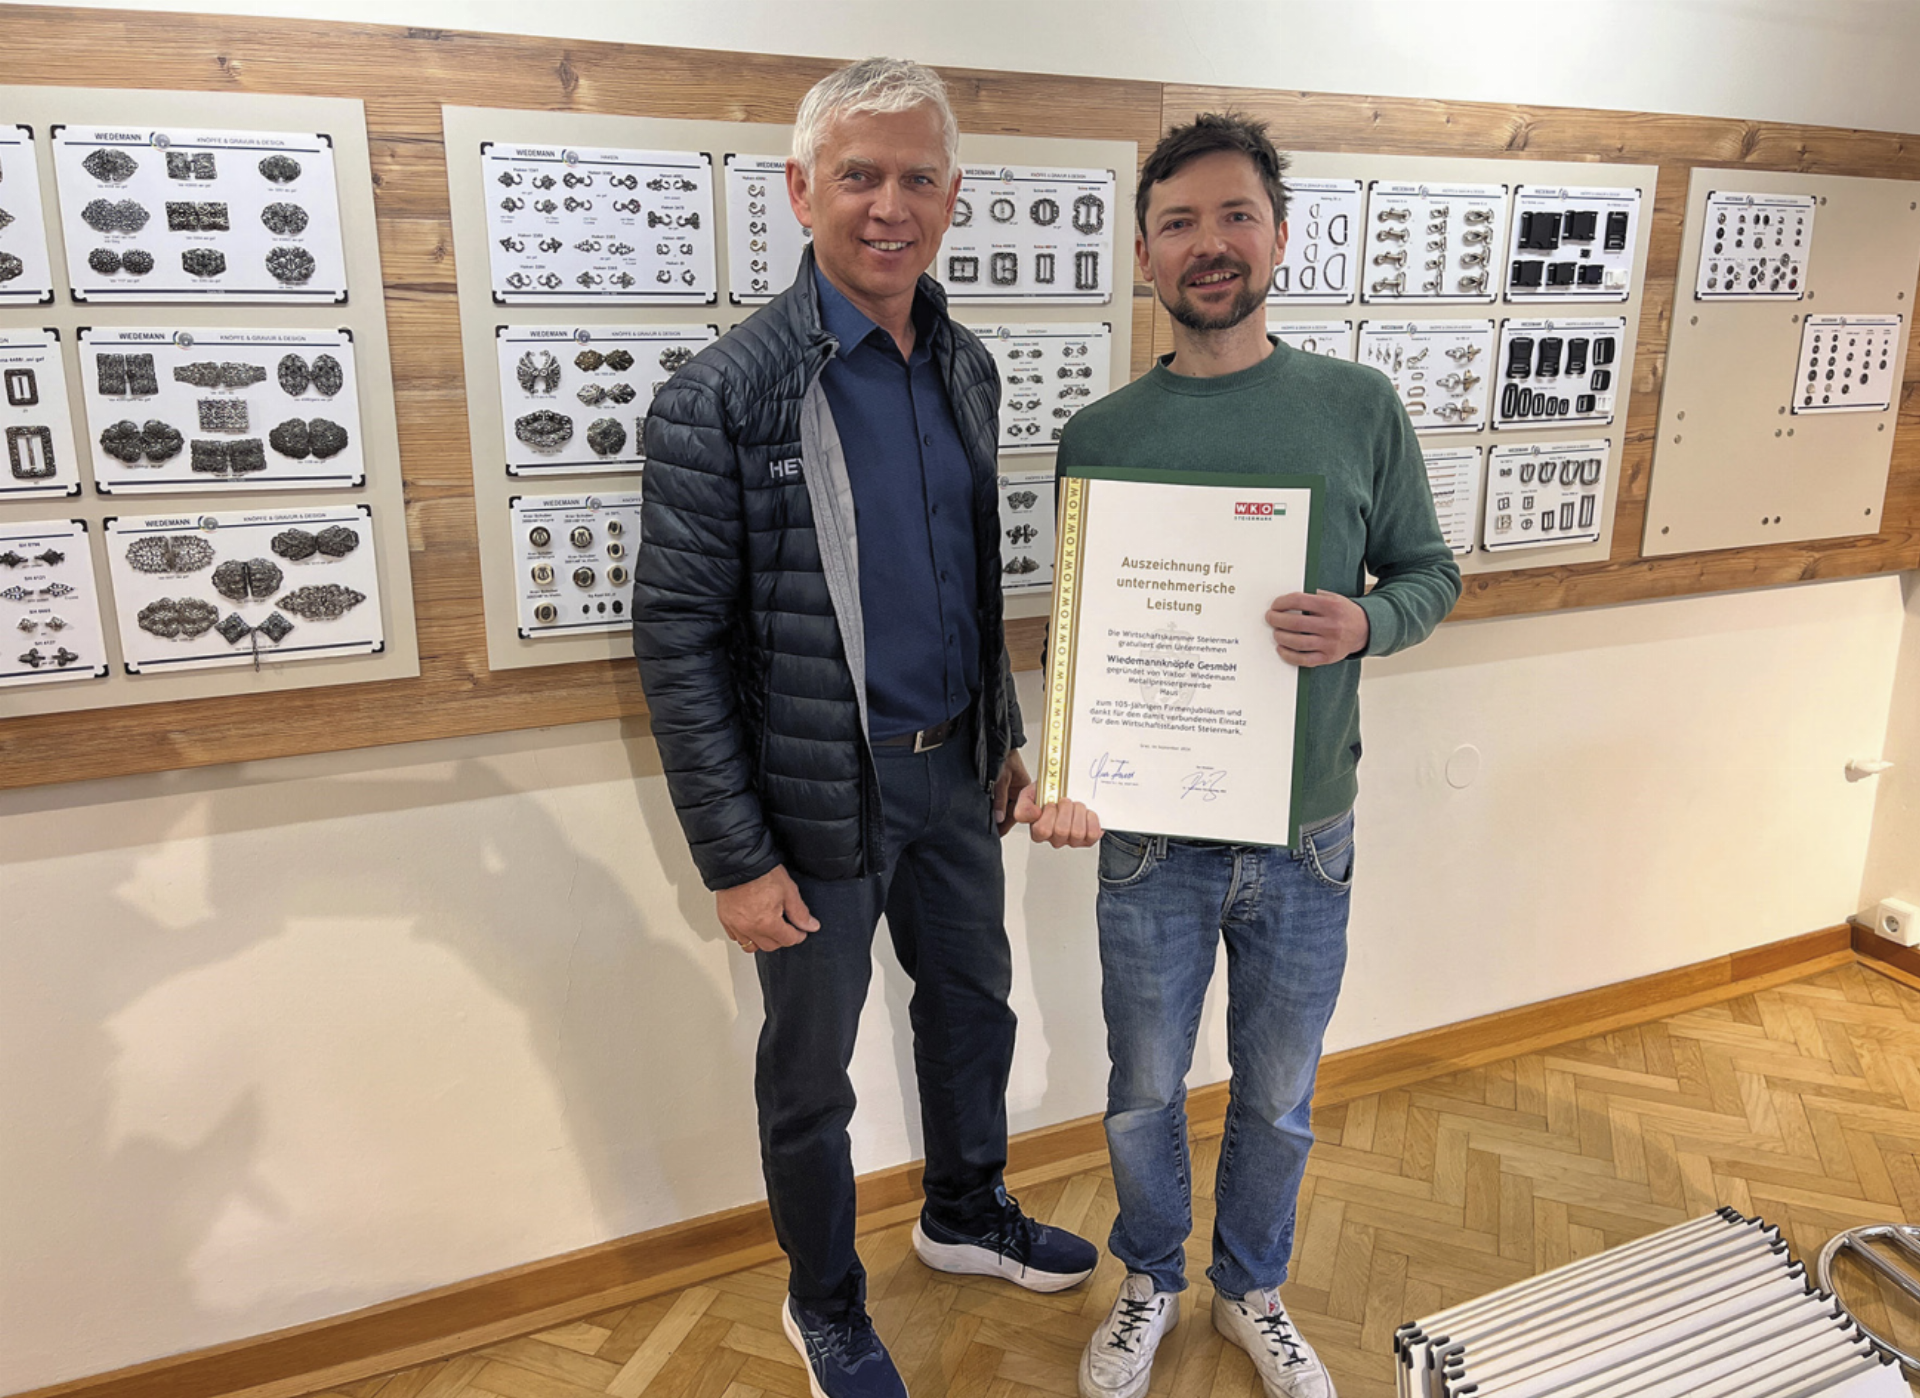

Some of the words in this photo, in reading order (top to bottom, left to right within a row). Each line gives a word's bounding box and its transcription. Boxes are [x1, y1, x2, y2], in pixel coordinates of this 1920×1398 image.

[94, 133, 142, 141] WIEDEMANN
[516, 149, 555, 158] WIEDEMANN
[529, 330, 568, 338] WIEDEMANN
[543, 499, 580, 507] WIEDEMANN
[1236, 503, 1272, 514] WKO
[145, 519, 191, 528] WIEDEMANN
[1121, 556, 1210, 575] Auszeichnung
[1214, 562, 1234, 574] für
[1117, 577, 1236, 594] unternehmerische
[1147, 598, 1202, 615] Leistung
[1107, 629, 1121, 637] Die
[1122, 630, 1195, 642] Wirtschaftskammer
[1197, 636, 1239, 645] Steiermark
[1118, 640, 1154, 649] gratuliert
[1155, 642, 1172, 650] dem
[1174, 643, 1227, 653] Unternehmen
[1106, 654, 1195, 670] Wiedemannknöpfe
[1197, 661, 1237, 672] GesmbH
[1106, 666, 1145, 676] gegründet
[1147, 669, 1161, 677] von
[1162, 670, 1186, 678] Viktor
[1190, 672, 1236, 681] Wiedemann
[1089, 708, 1111, 716] dankt
[1113, 709, 1124, 717] für
[1126, 710, 1141, 718] den
[1142, 712, 1164, 720] damit
[1165, 714, 1217, 724] verbundenen
[1218, 717, 1247, 726] Einsatz
[1163, 703, 1225, 716] Firmenjubiläum
[1226, 709, 1242, 717] und
[1091, 717, 1103, 725] für
[1105, 718, 1120, 726] den
[1121, 719, 1196, 733] Wirtschaftsstandort
